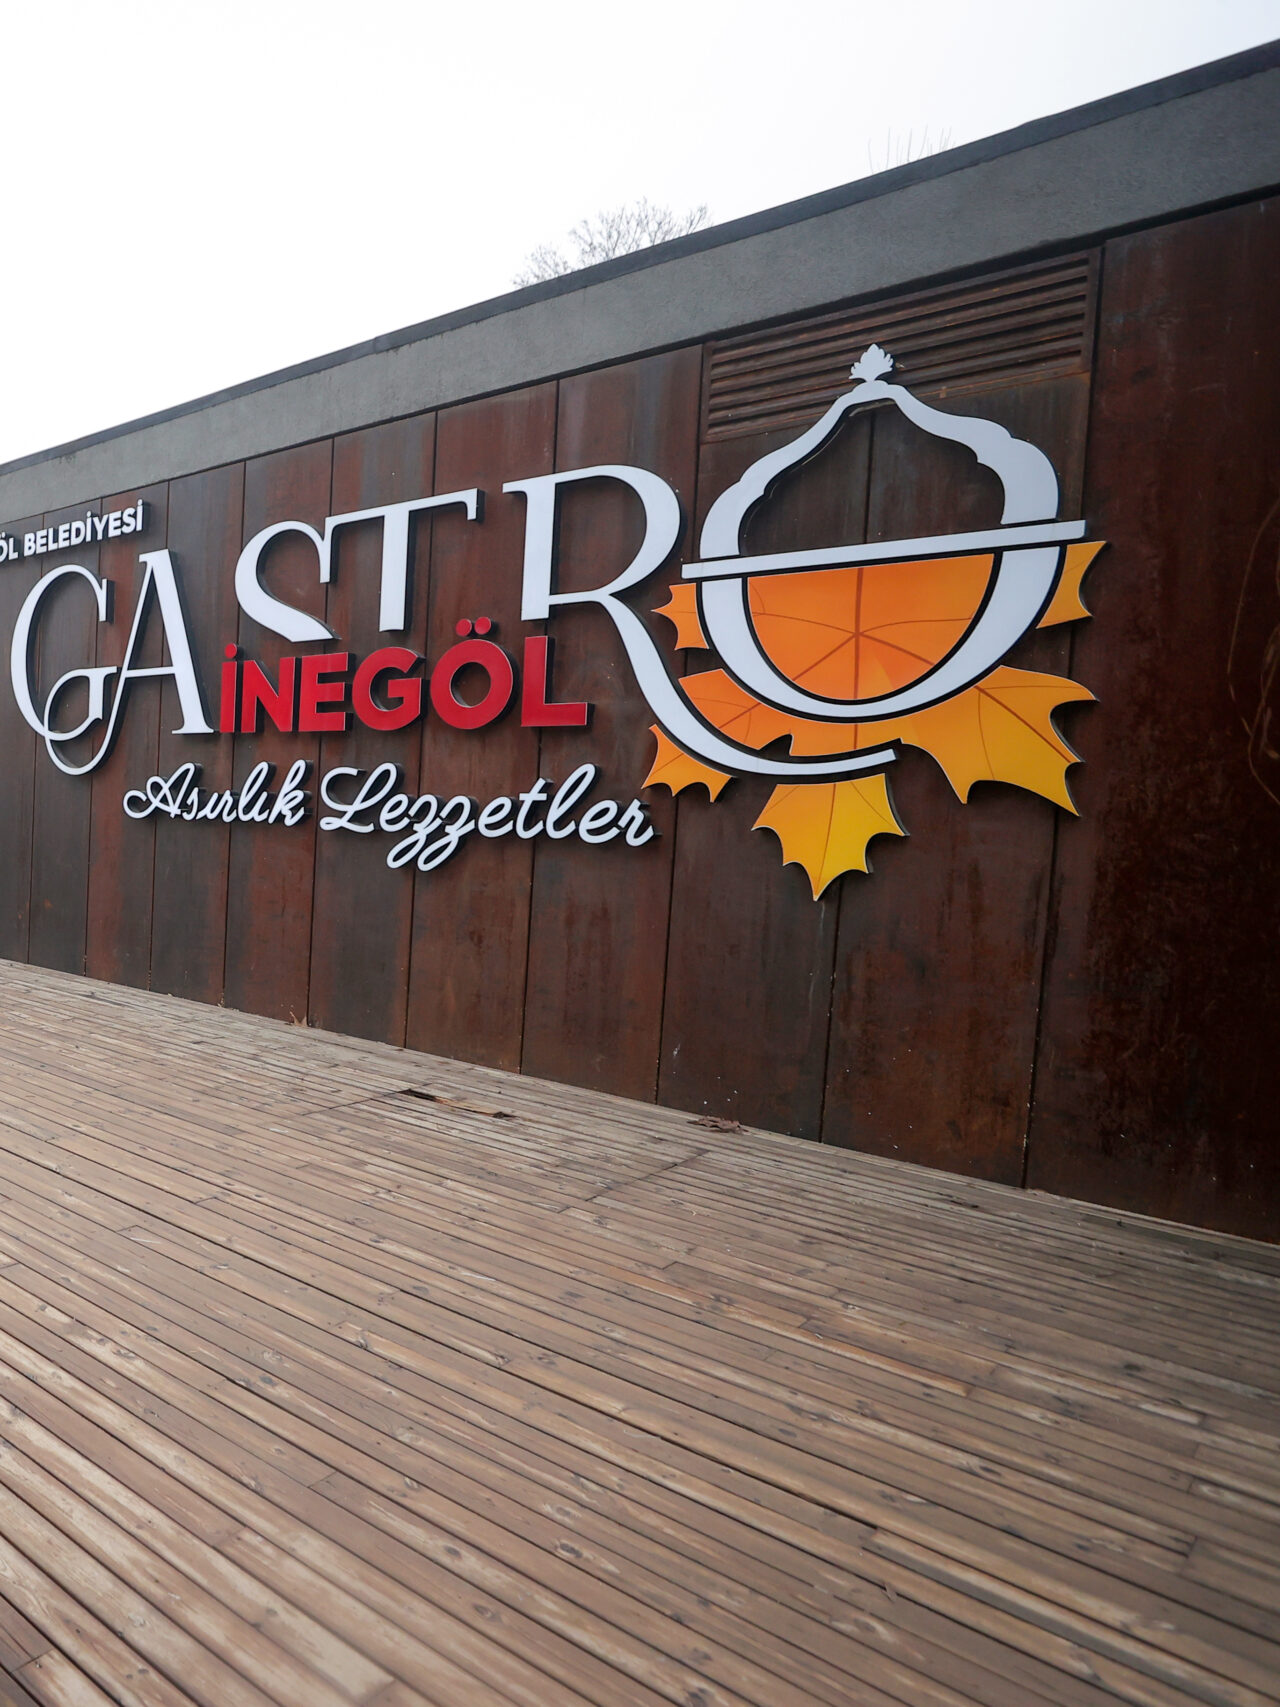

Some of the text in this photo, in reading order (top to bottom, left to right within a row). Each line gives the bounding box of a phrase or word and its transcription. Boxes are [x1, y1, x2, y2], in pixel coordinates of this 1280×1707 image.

[10, 343, 1086, 776] GASTRO
[23, 498, 144, 557] BELEDİYESİ
[220, 616, 588, 733] İNEGÖL
[122, 759, 655, 872] Asırlık Lezzetler
